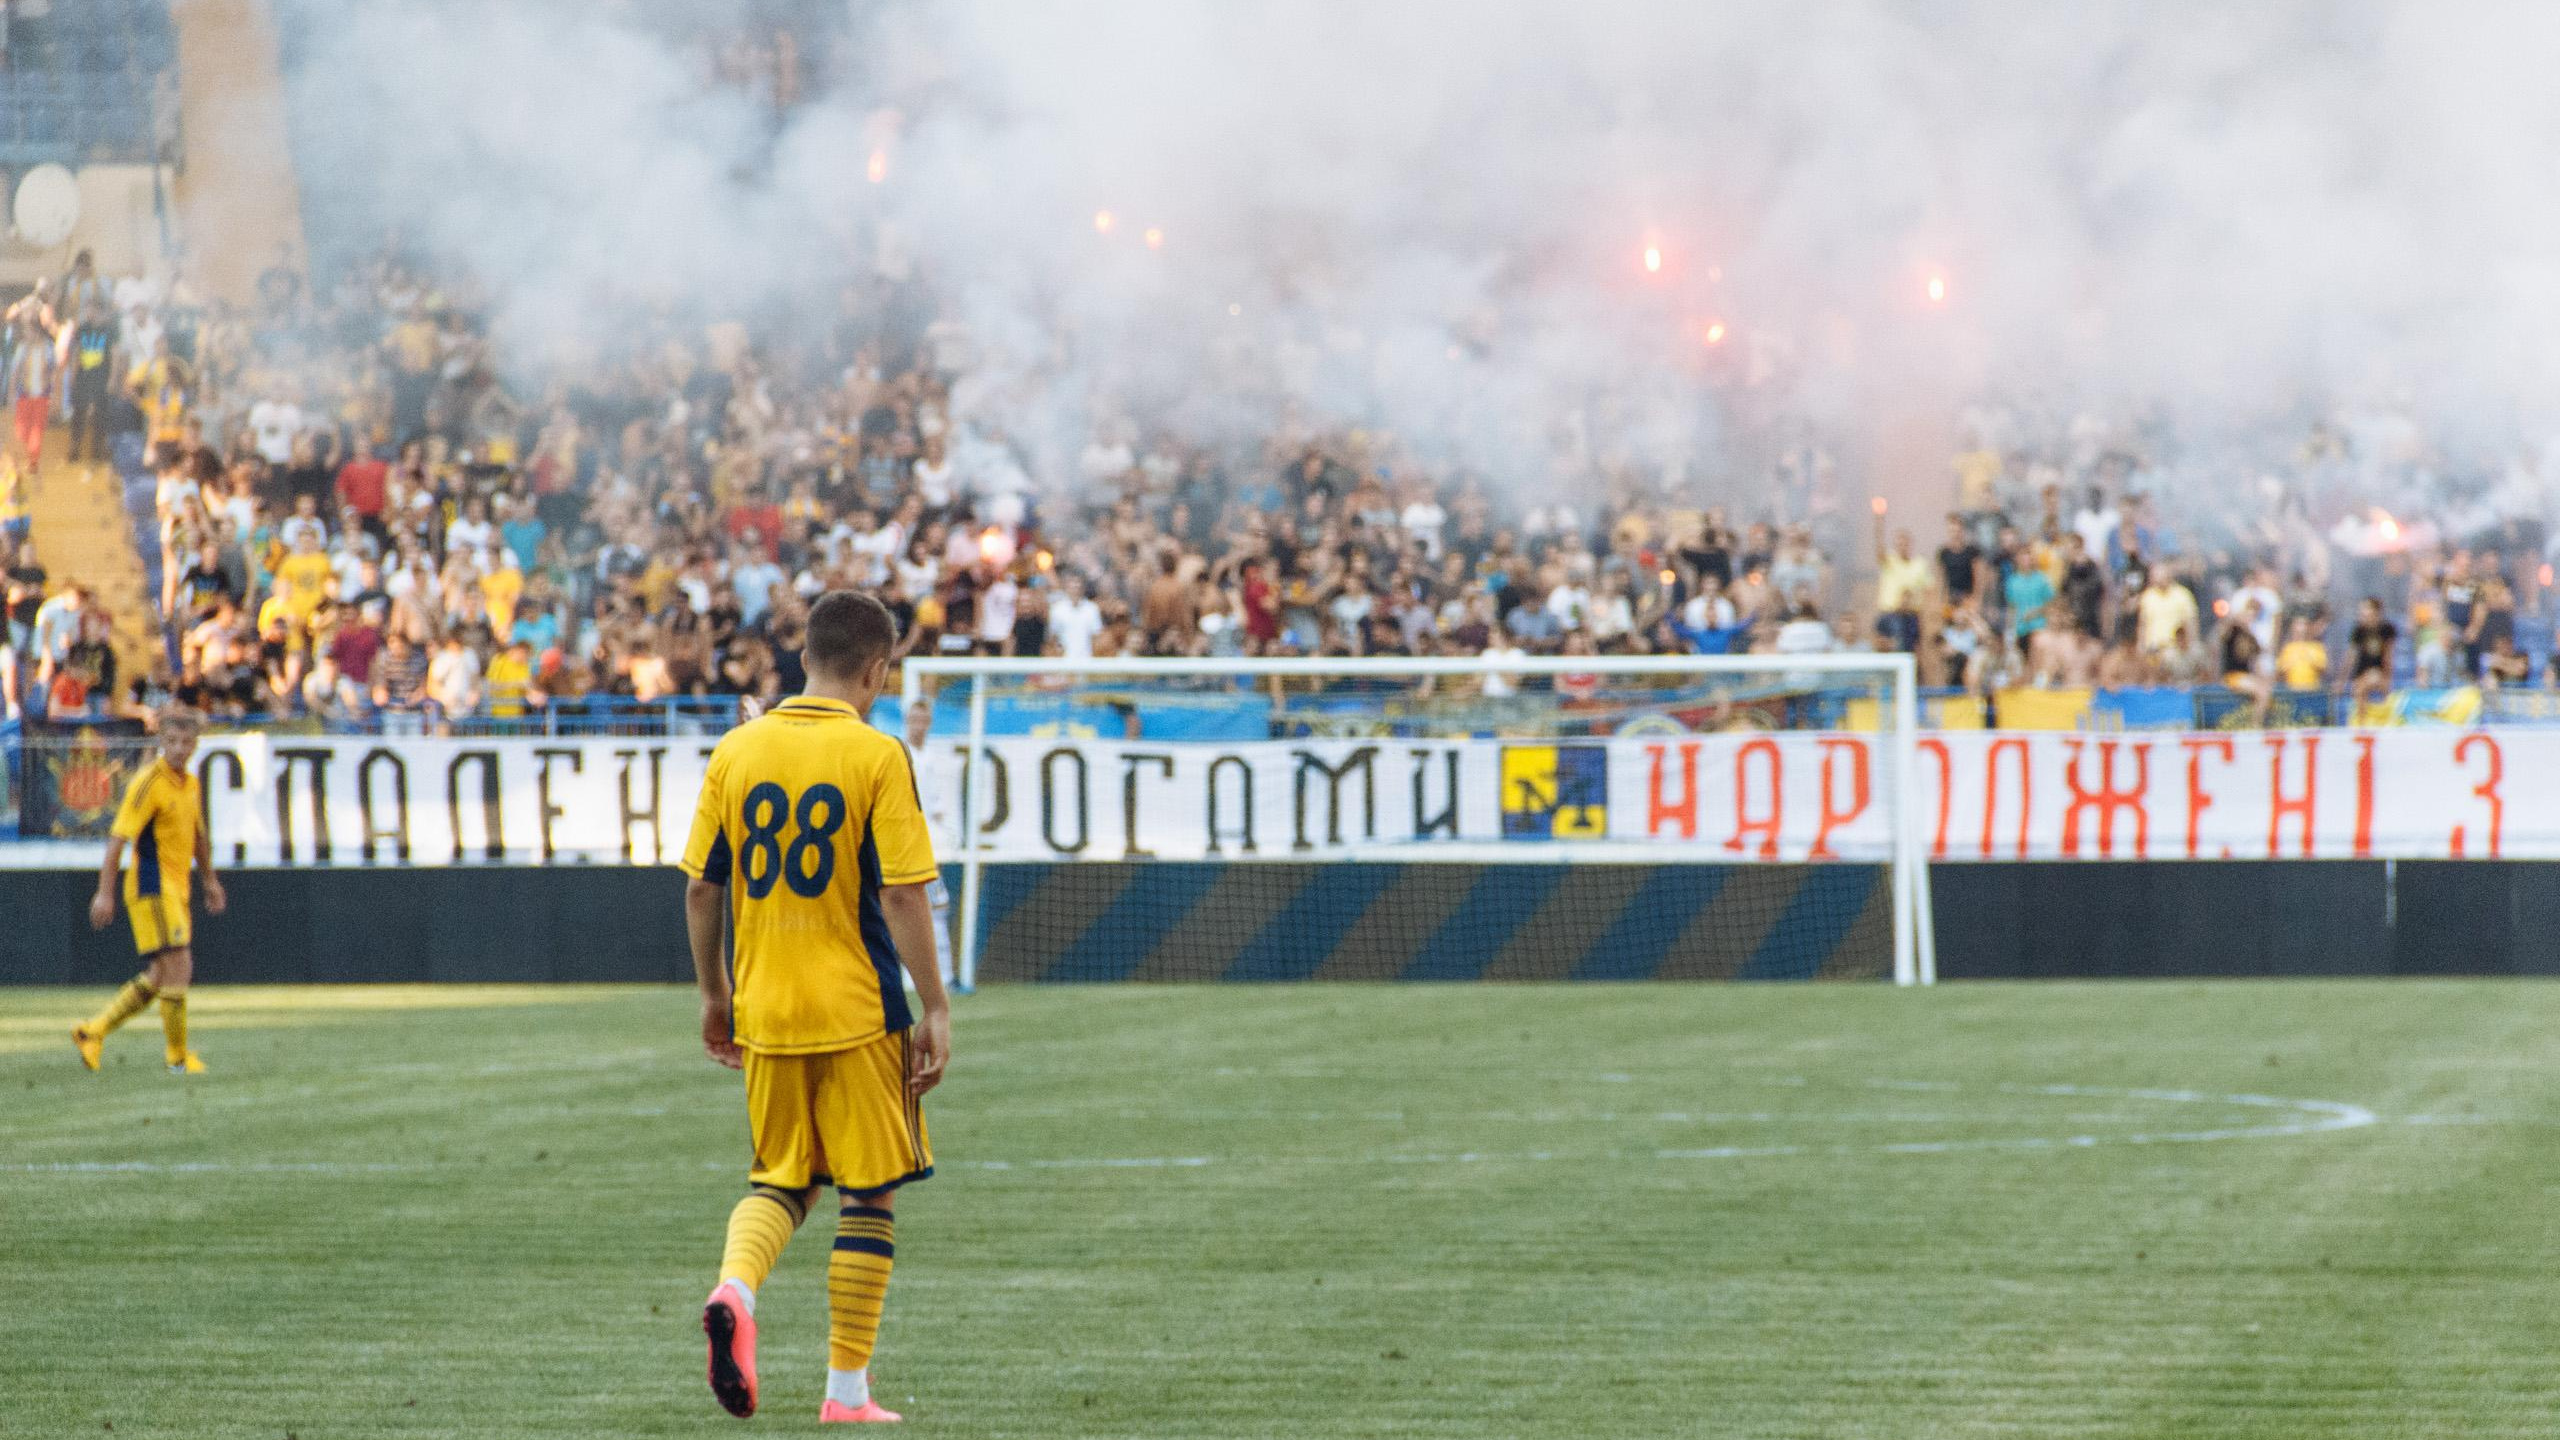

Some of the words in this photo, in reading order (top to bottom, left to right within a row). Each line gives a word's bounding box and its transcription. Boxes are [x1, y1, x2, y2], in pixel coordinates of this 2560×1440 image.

[199, 747, 714, 860] СПАЛЕН
[953, 746, 1459, 858] РОГАМИ
[740, 781, 846, 900] 88
